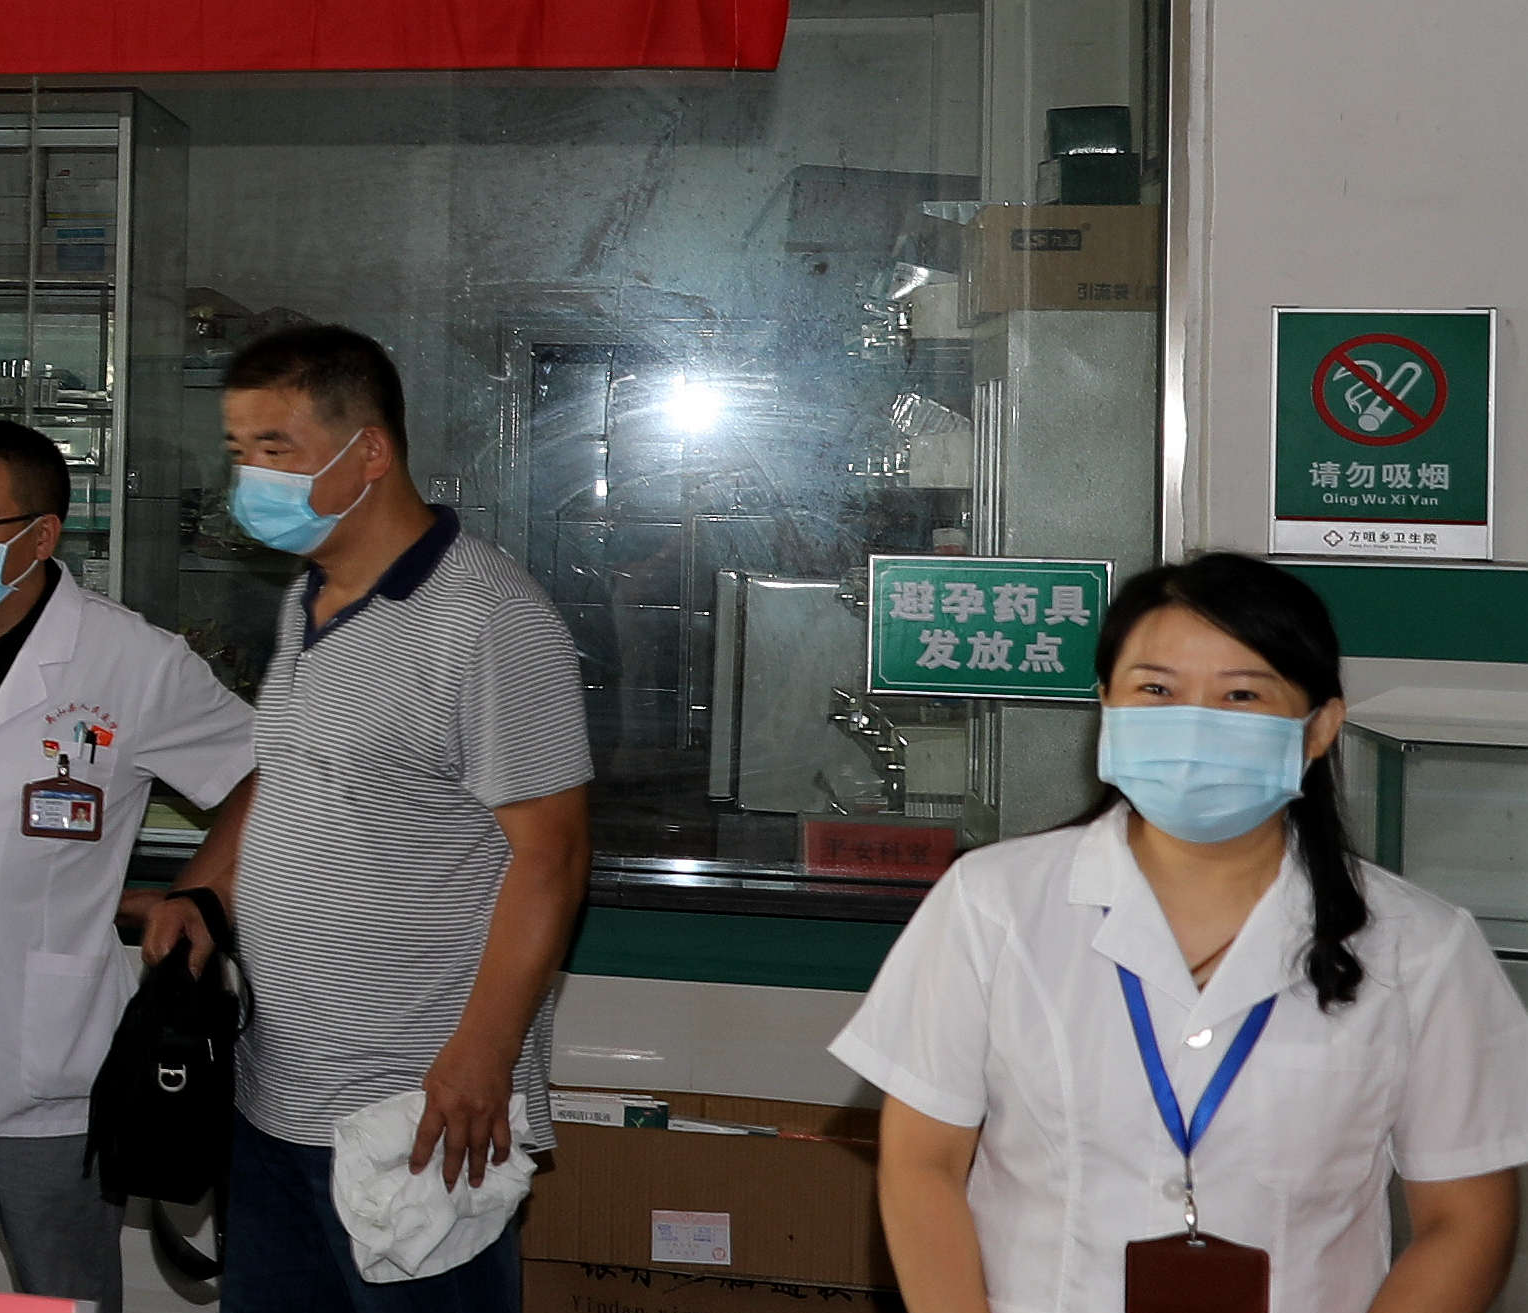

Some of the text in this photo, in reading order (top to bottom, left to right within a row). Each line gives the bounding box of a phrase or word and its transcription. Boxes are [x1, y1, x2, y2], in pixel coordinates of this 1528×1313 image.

[1309, 461, 1450, 490] 请勿吸烟
[1323, 493, 1438, 506] Qing Wu Xi Yan
[889, 581, 1091, 626] 避孕药具
[916, 629, 1064, 673] 发放点
